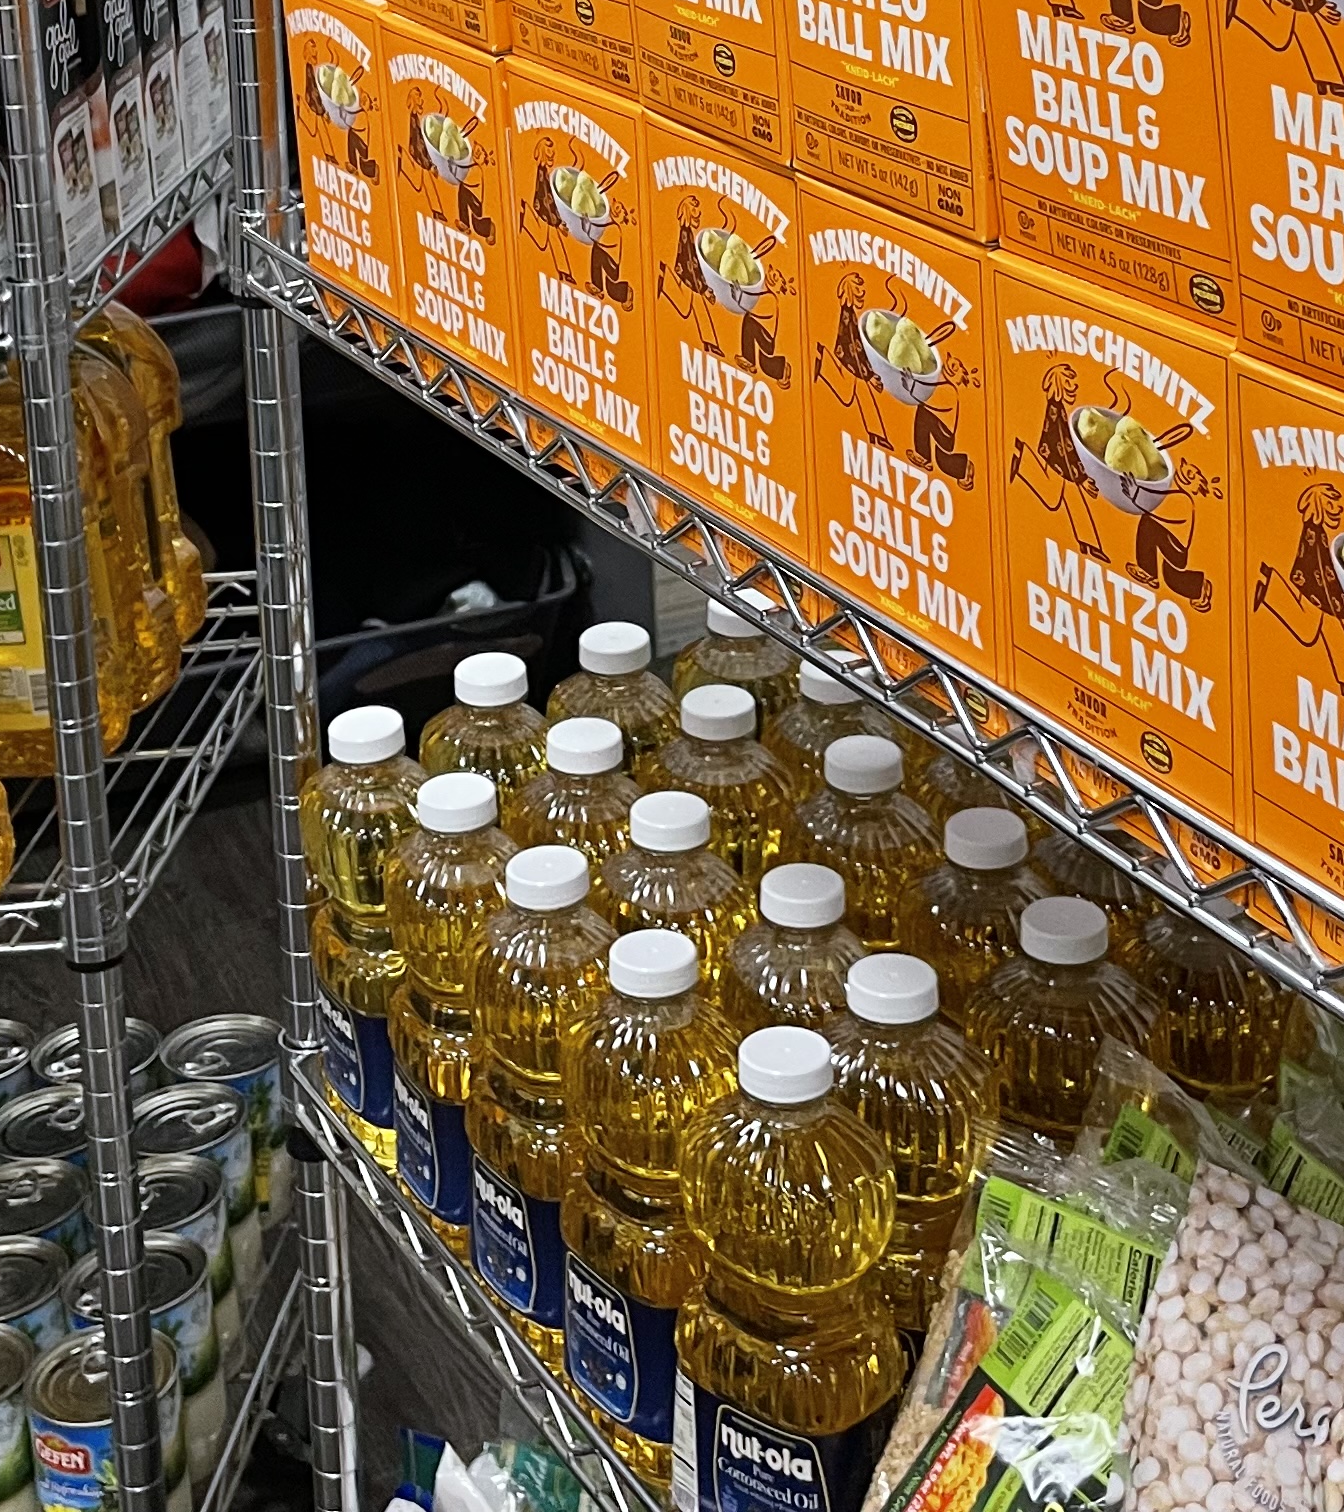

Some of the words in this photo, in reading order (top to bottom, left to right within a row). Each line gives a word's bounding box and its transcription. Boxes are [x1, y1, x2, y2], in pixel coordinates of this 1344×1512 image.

[721, 1423, 813, 1481] nut-ola
[1216, 1410, 1244, 1479] NATURAL
[794, 1492, 818, 1510] Oil
